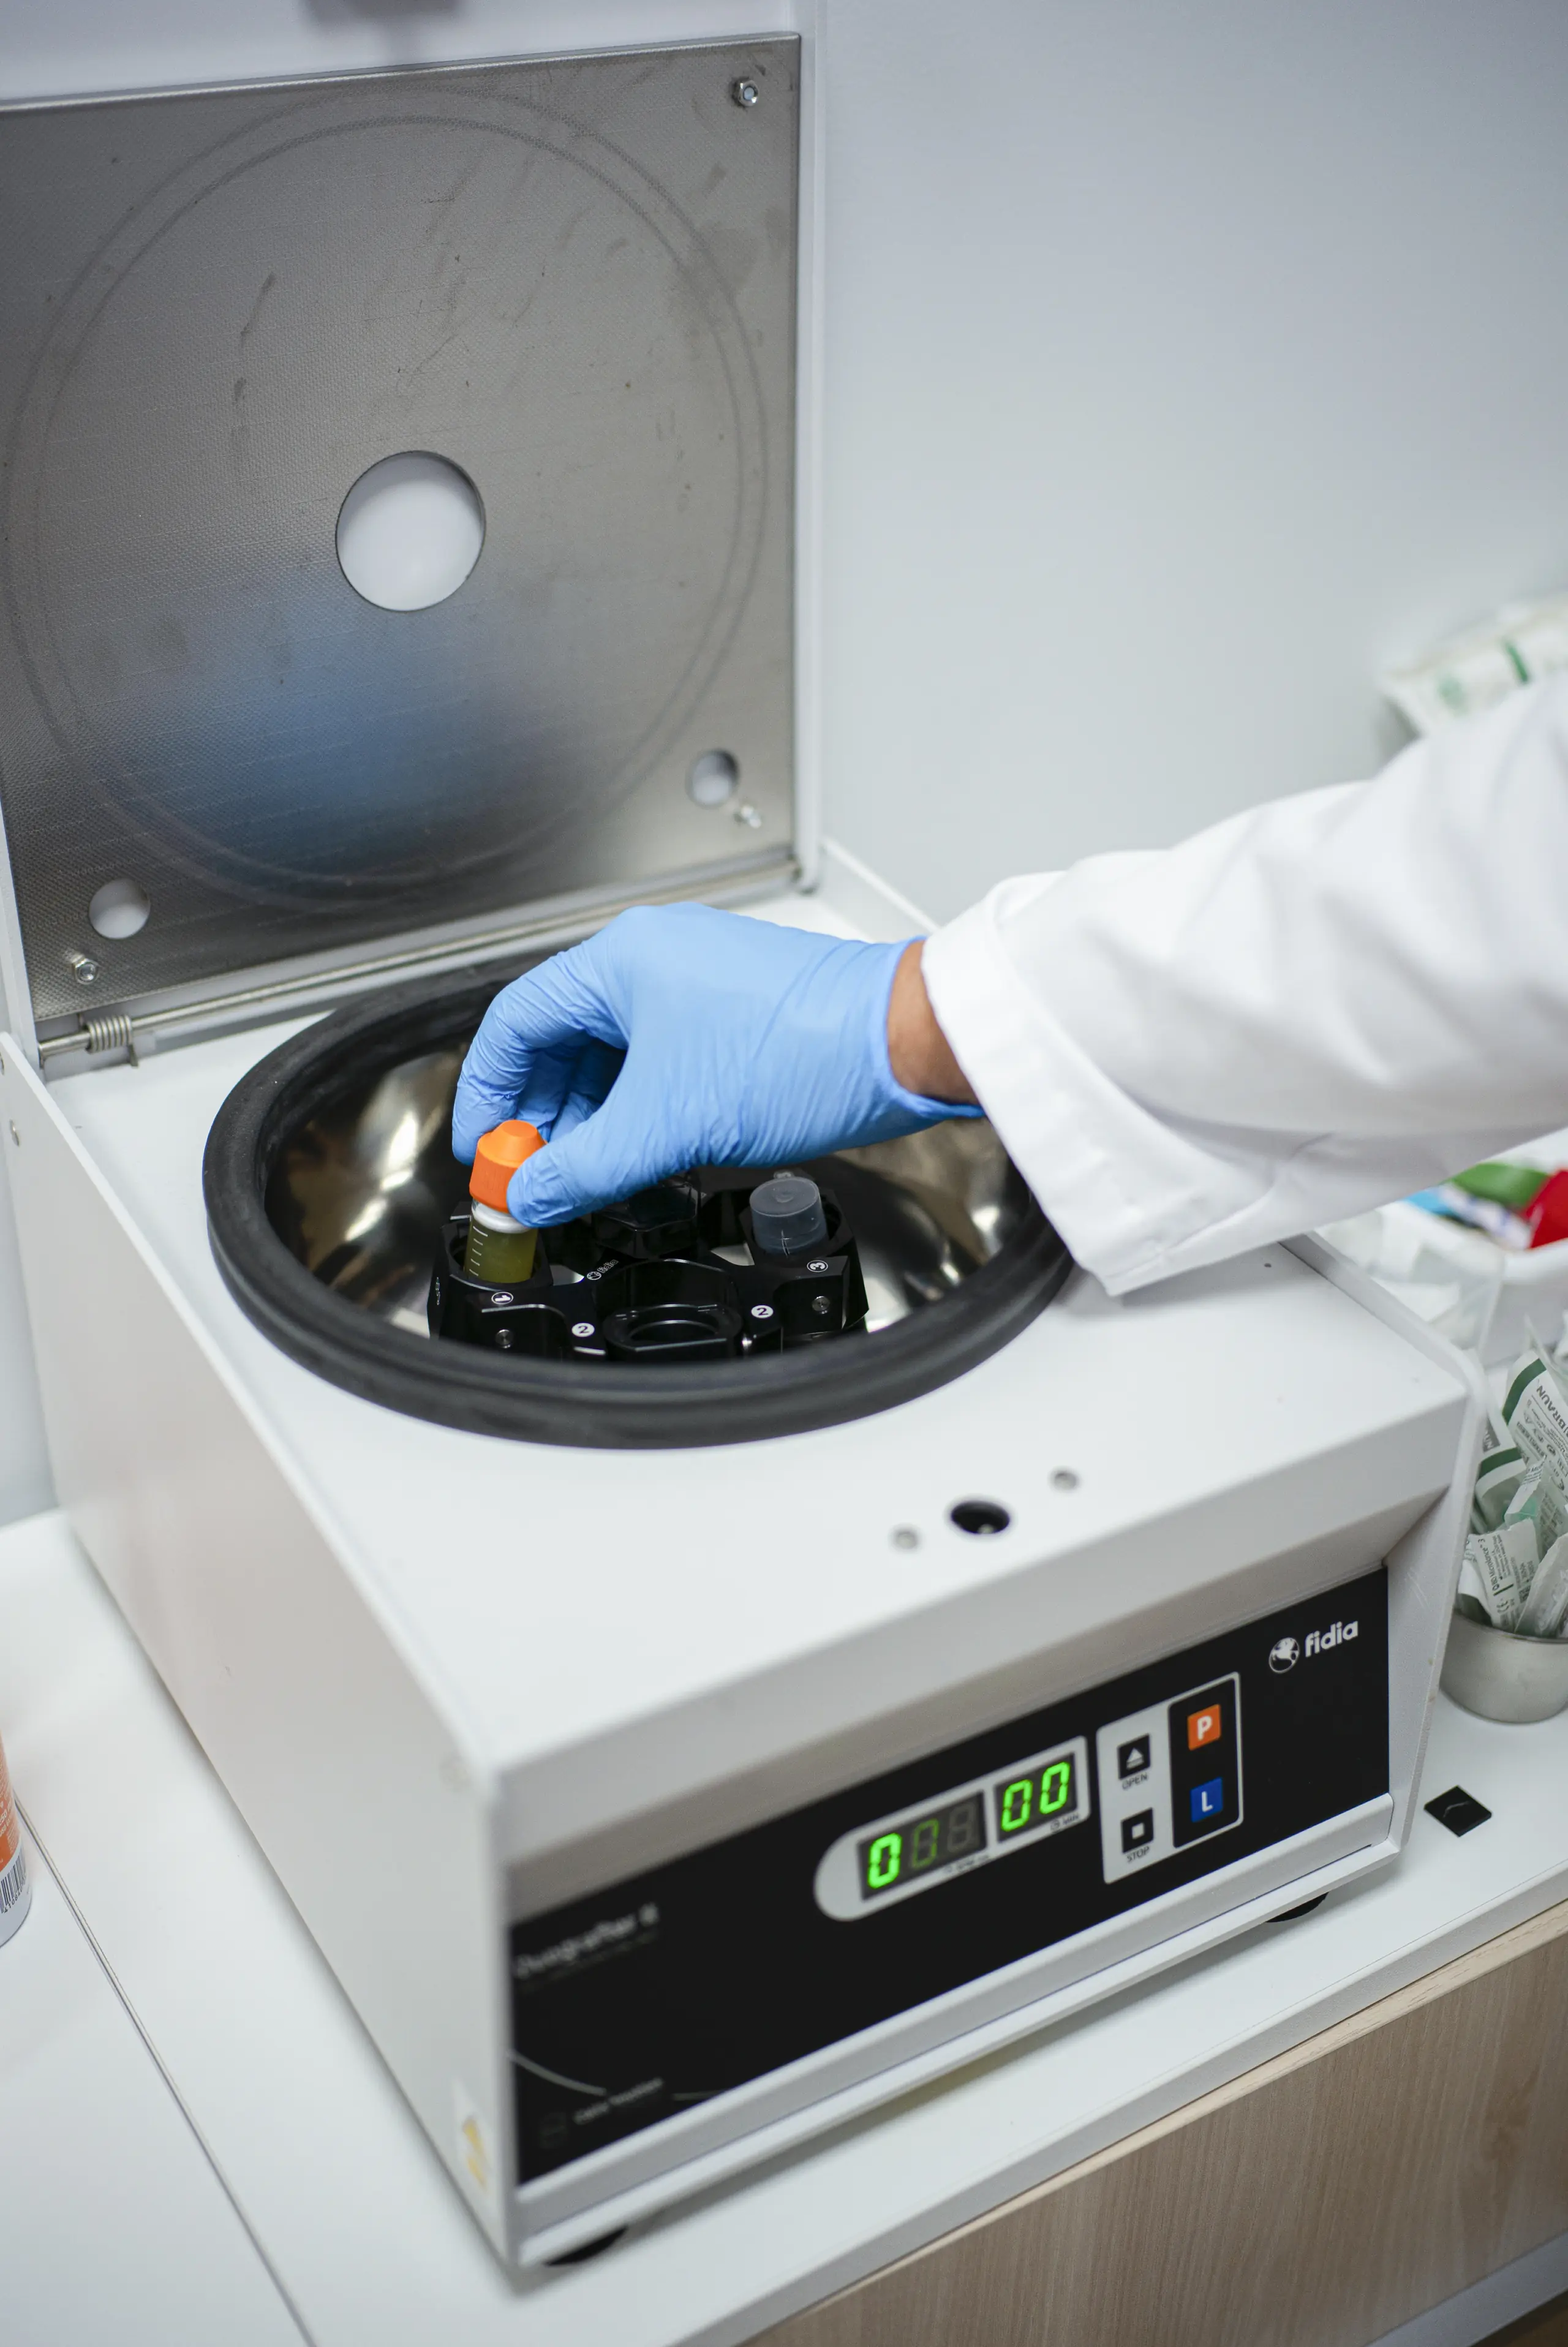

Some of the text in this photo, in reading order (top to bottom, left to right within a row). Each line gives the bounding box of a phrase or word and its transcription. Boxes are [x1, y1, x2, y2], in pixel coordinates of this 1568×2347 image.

[597, 1259, 619, 1273] fidia
[756, 1307, 769, 1316] 2
[578, 1325, 590, 1334] 2
[1305, 1621, 1359, 1658] fidia
[1197, 1716, 1212, 1741] P
[1121, 1772, 1148, 1791] OPEN
[1001, 1761, 1070, 1832] 00
[1201, 1791, 1213, 1813] L
[1126, 1846, 1150, 1863] STOP
